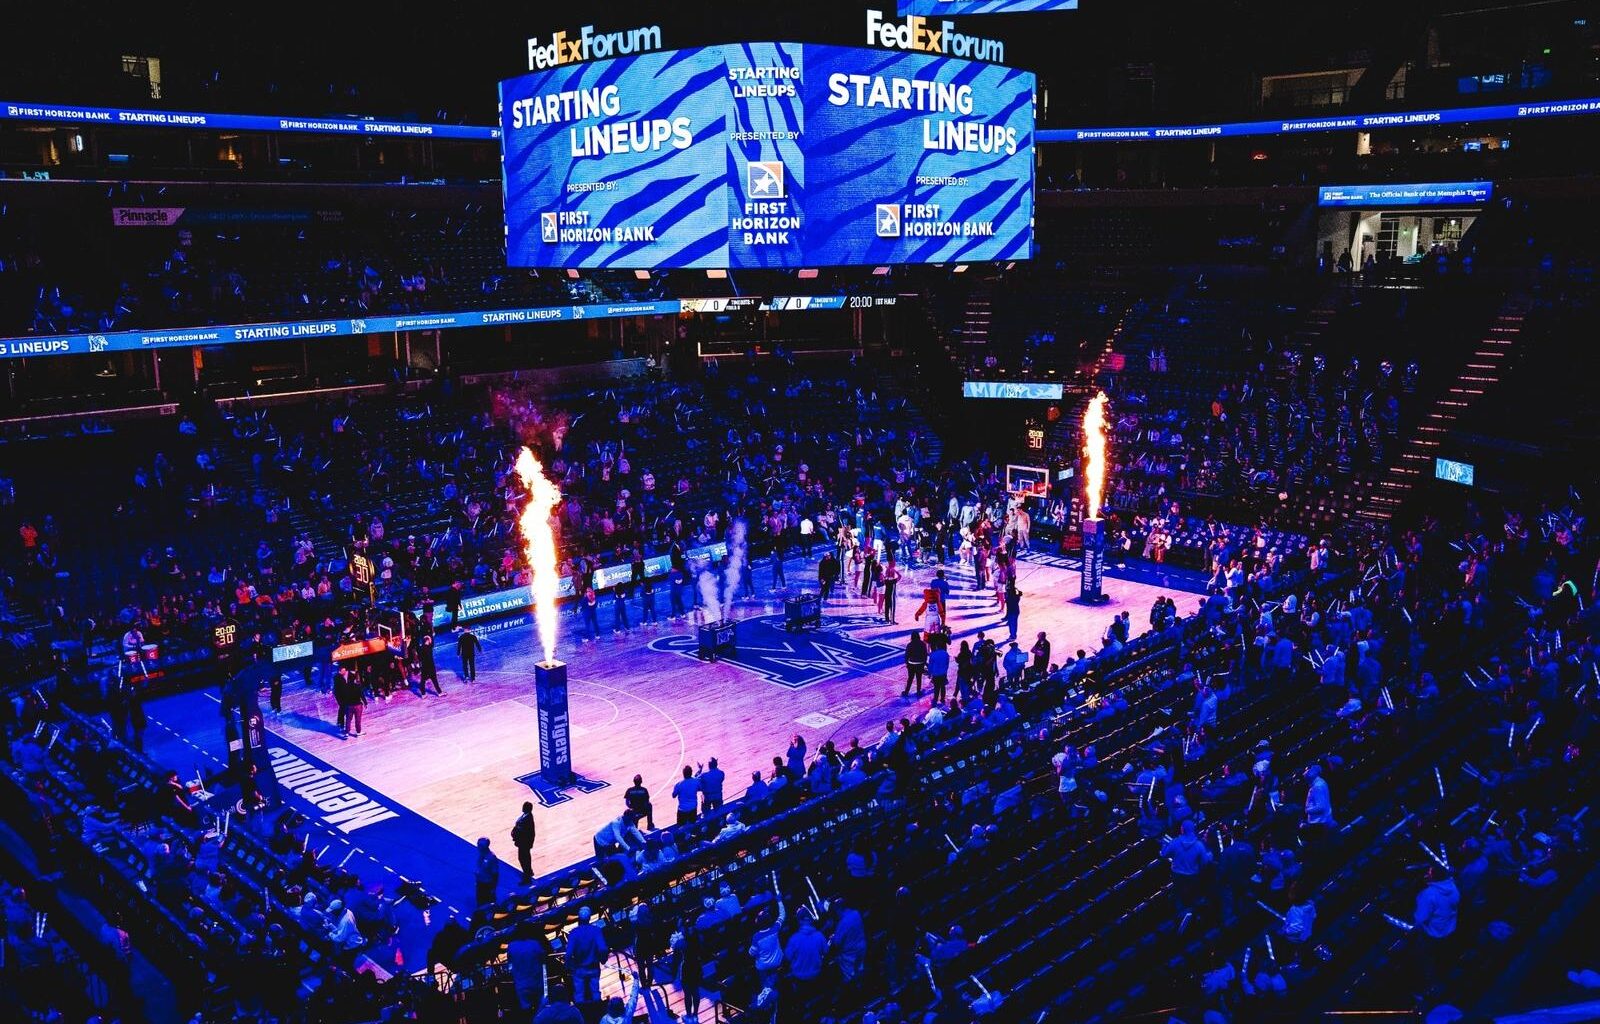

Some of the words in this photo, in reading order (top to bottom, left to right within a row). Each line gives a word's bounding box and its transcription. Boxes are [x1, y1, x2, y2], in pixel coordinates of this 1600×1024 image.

[866, 9, 1004, 63] FedExForum
[527, 25, 662, 71] FedExForum
[728, 67, 800, 81] STARTING
[734, 85, 796, 98] LINEUPS
[828, 73, 973, 116] STARTING
[19, 108, 43, 116] FIRST
[45, 109, 85, 119] HORIZON
[512, 85, 621, 129] STARTING
[1551, 104, 1589, 113] HORIZON
[119, 112, 166, 122] STARTING
[167, 115, 206, 124] LINEUPS
[1363, 116, 1404, 125] STARTING
[1404, 113, 1441, 123] LINEUPS
[307, 122, 338, 130] HORIZON
[364, 124, 401, 133] STARTING
[402, 126, 433, 134] LINEUPS
[1155, 129, 1192, 137] STARTING
[1193, 127, 1221, 135] LINEUPS
[570, 117, 693, 157] LINEUPS
[730, 131, 785, 141] PRESENTED
[788, 131, 800, 140] BY
[923, 119, 1017, 155] LINEUPS
[566, 182, 605, 192] PRESENTED
[916, 176, 957, 186] PRESENTED
[744, 202, 787, 215] FIRST
[904, 204, 940, 219] FIRST
[559, 211, 589, 225] FIRST
[732, 217, 800, 231] HORIZON
[560, 227, 611, 242] HORIZON
[904, 222, 961, 236] HORIZON
[743, 232, 789, 245] BANK
[713, 301, 718, 310] 0
[796, 298, 801, 308] 0
[482, 311, 525, 323] STARTING
[526, 309, 562, 320] LINEUPS
[235, 327, 290, 339] STARTING
[292, 324, 337, 336] LINEUPS
[11, 341, 69, 354] LINEUPS
[1029, 437, 1042, 448] 30
[356, 564, 369, 584] 30
[1084, 549, 1094, 591] Memphis
[465, 598, 486, 609] FIRST
[467, 604, 501, 618] HORIZON
[502, 598, 524, 610] BANK
[215, 624, 236, 636] 20:00
[219, 633, 234, 645] 30
[539, 709, 551, 769] Memphis
[551, 711, 568, 766] Tigers
